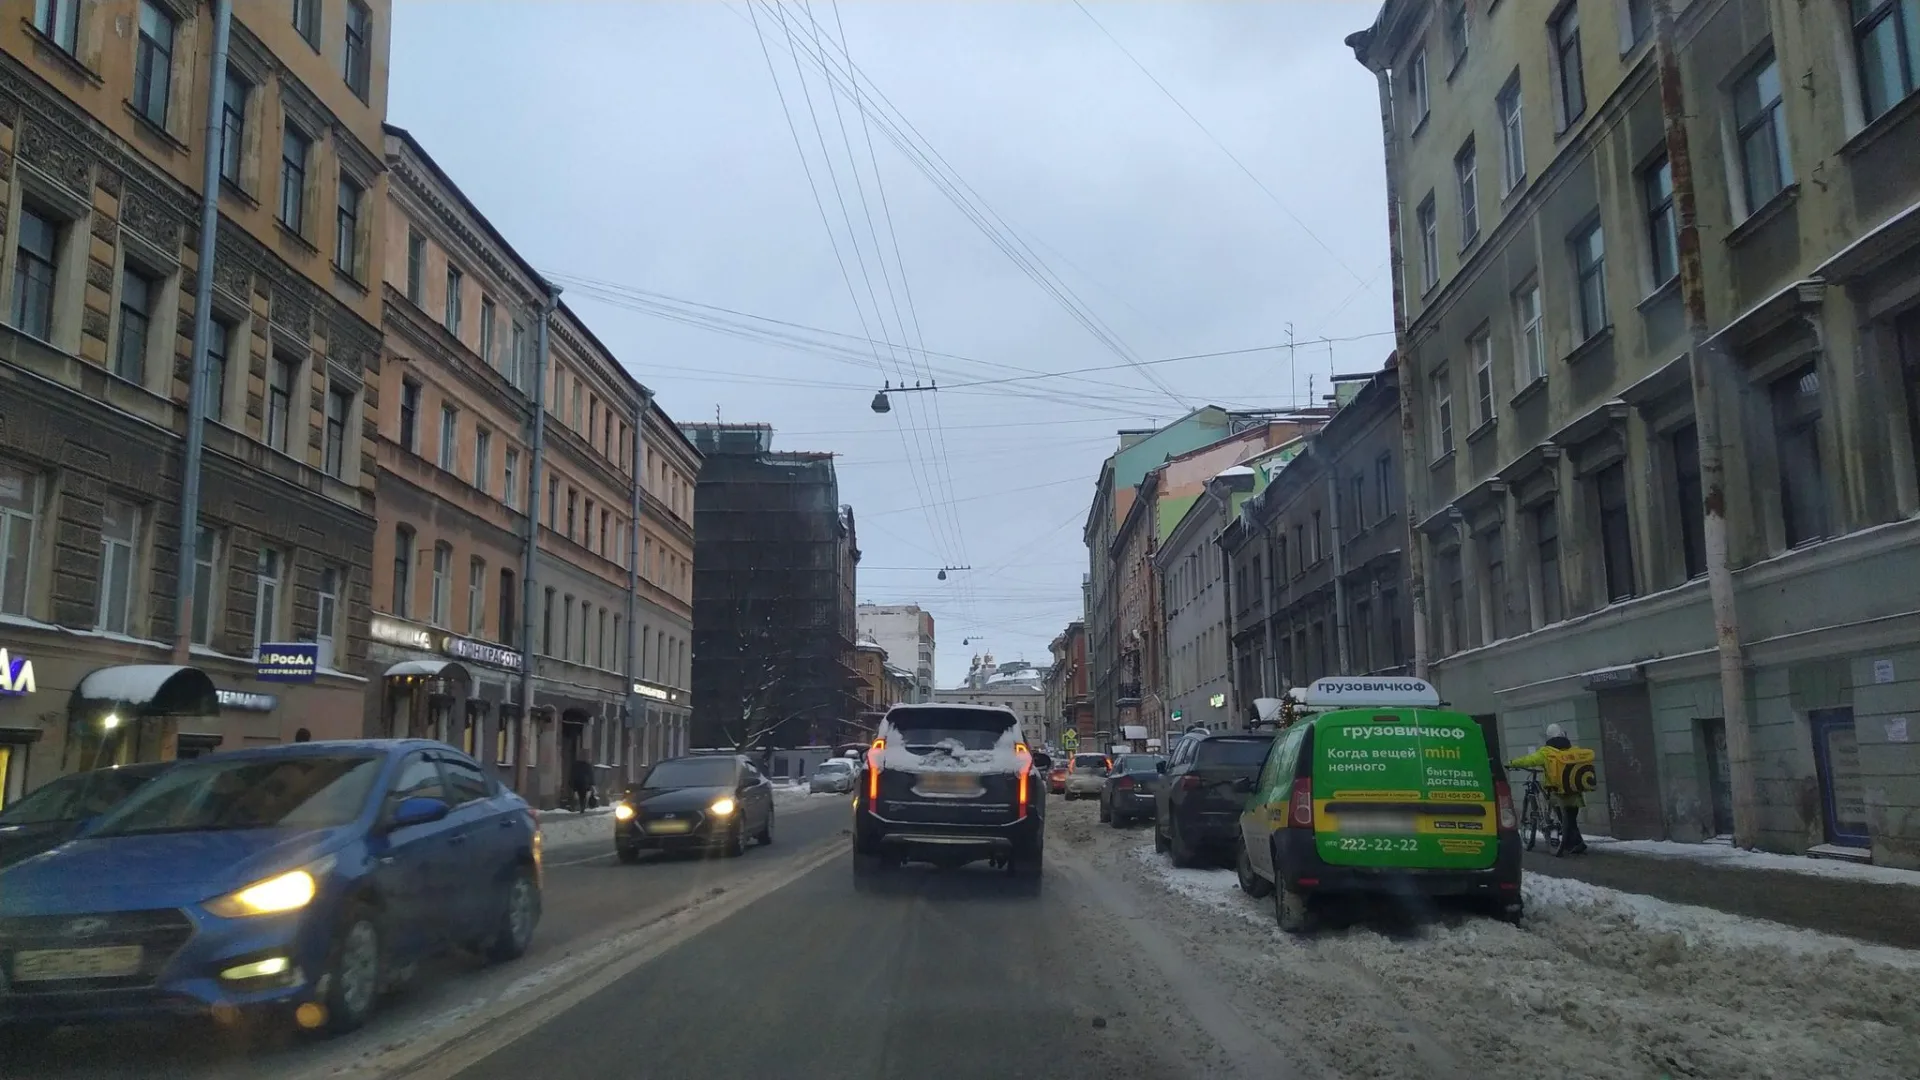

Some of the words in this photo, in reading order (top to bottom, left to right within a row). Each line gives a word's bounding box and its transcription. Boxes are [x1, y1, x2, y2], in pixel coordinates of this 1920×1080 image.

[1318, 682, 1426, 694] грузовичкоф
[1343, 726, 1465, 739] грузовичкоф
[1327, 748, 1368, 760] Когда
[1372, 747, 1416, 759] вещей
[1424, 746, 1461, 760] mini
[1328, 763, 1387, 772] немного
[1426, 766, 1474, 778] быстрая
[1427, 776, 1480, 787] доставка
[1339, 838, 1418, 851] 222-22-22
